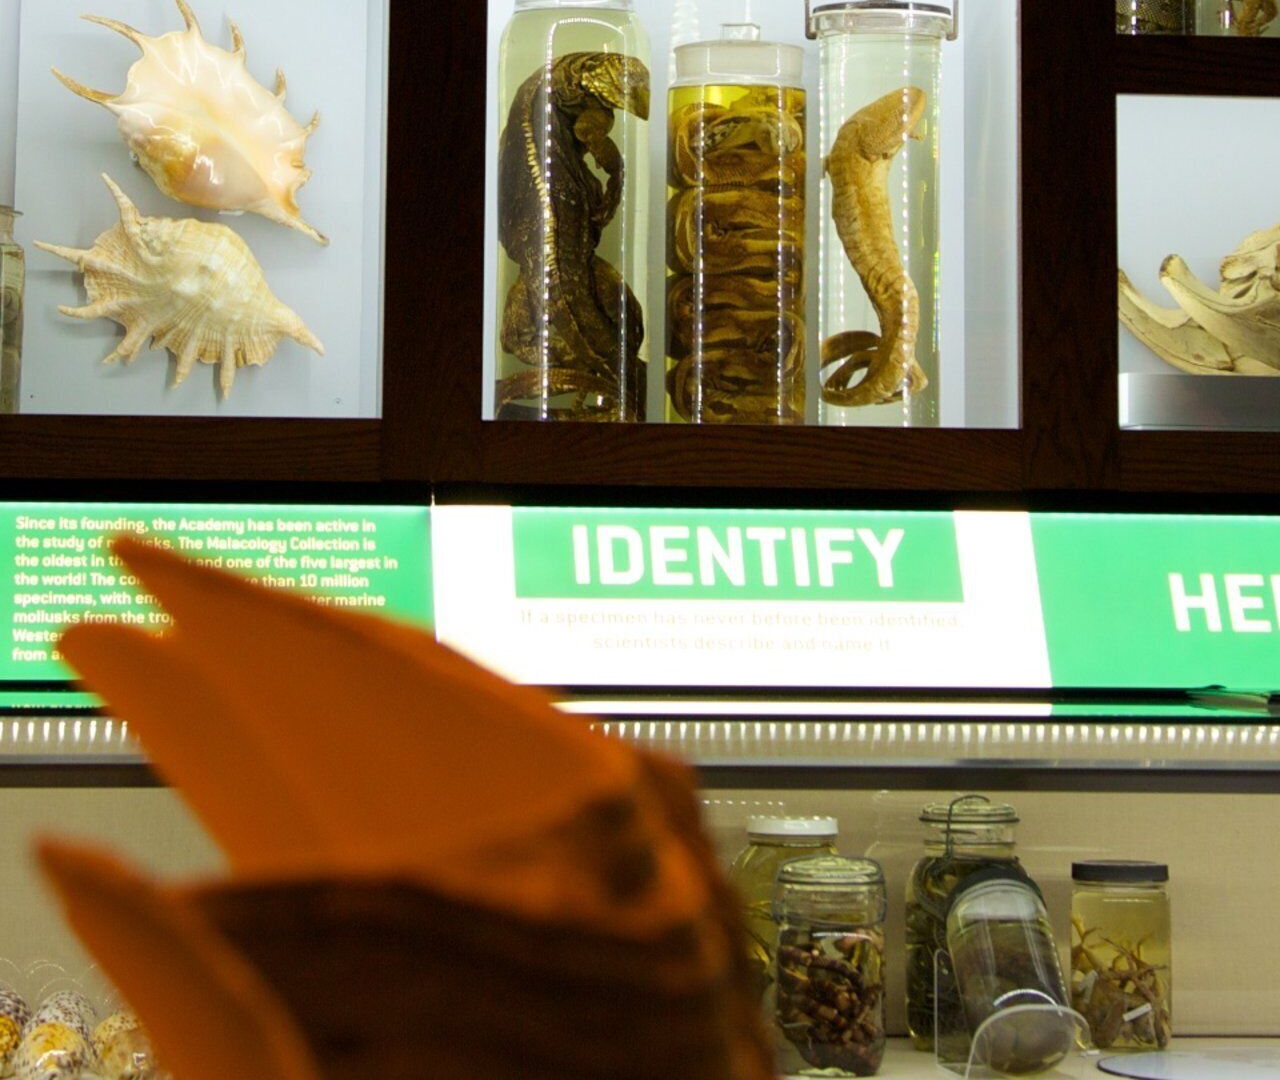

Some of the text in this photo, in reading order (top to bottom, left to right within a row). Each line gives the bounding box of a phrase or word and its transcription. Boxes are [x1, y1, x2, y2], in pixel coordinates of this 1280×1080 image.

[16, 516, 377, 535] Since its founding, the Academy has been active in
[15, 535, 40, 549] the
[42, 536, 85, 552] study
[88, 536, 104, 549] of
[178, 536, 204, 550] The
[207, 536, 288, 553] Malacology
[290, 537, 360, 551] Collection
[363, 537, 377, 551] is
[14, 554, 39, 567] the
[42, 554, 87, 568] oldest
[91, 554, 105, 567] in
[226, 557, 253, 569] one
[256, 555, 271, 569] of
[273, 555, 298, 569] the
[300, 555, 327, 570] five
[330, 556, 381, 573] largest
[384, 556, 399, 570] in
[571, 524, 905, 589] IDENTIFY
[13, 572, 39, 586] the
[42, 572, 87, 586] world!
[90, 572, 116, 586] The
[262, 574, 296, 588] than
[299, 574, 318, 587] 10
[320, 575, 369, 588] million
[13, 591, 96, 607] specimens,
[99, 591, 132, 605] with
[335, 593, 386, 607] marine
[12, 610, 80, 624] mollusks
[83, 610, 118, 624] from
[121, 610, 145, 624] the
[556, 610, 644, 628] specimen
[649, 610, 687, 625] has
[12, 628, 64, 643] Wester
[12, 647, 48, 662] from
